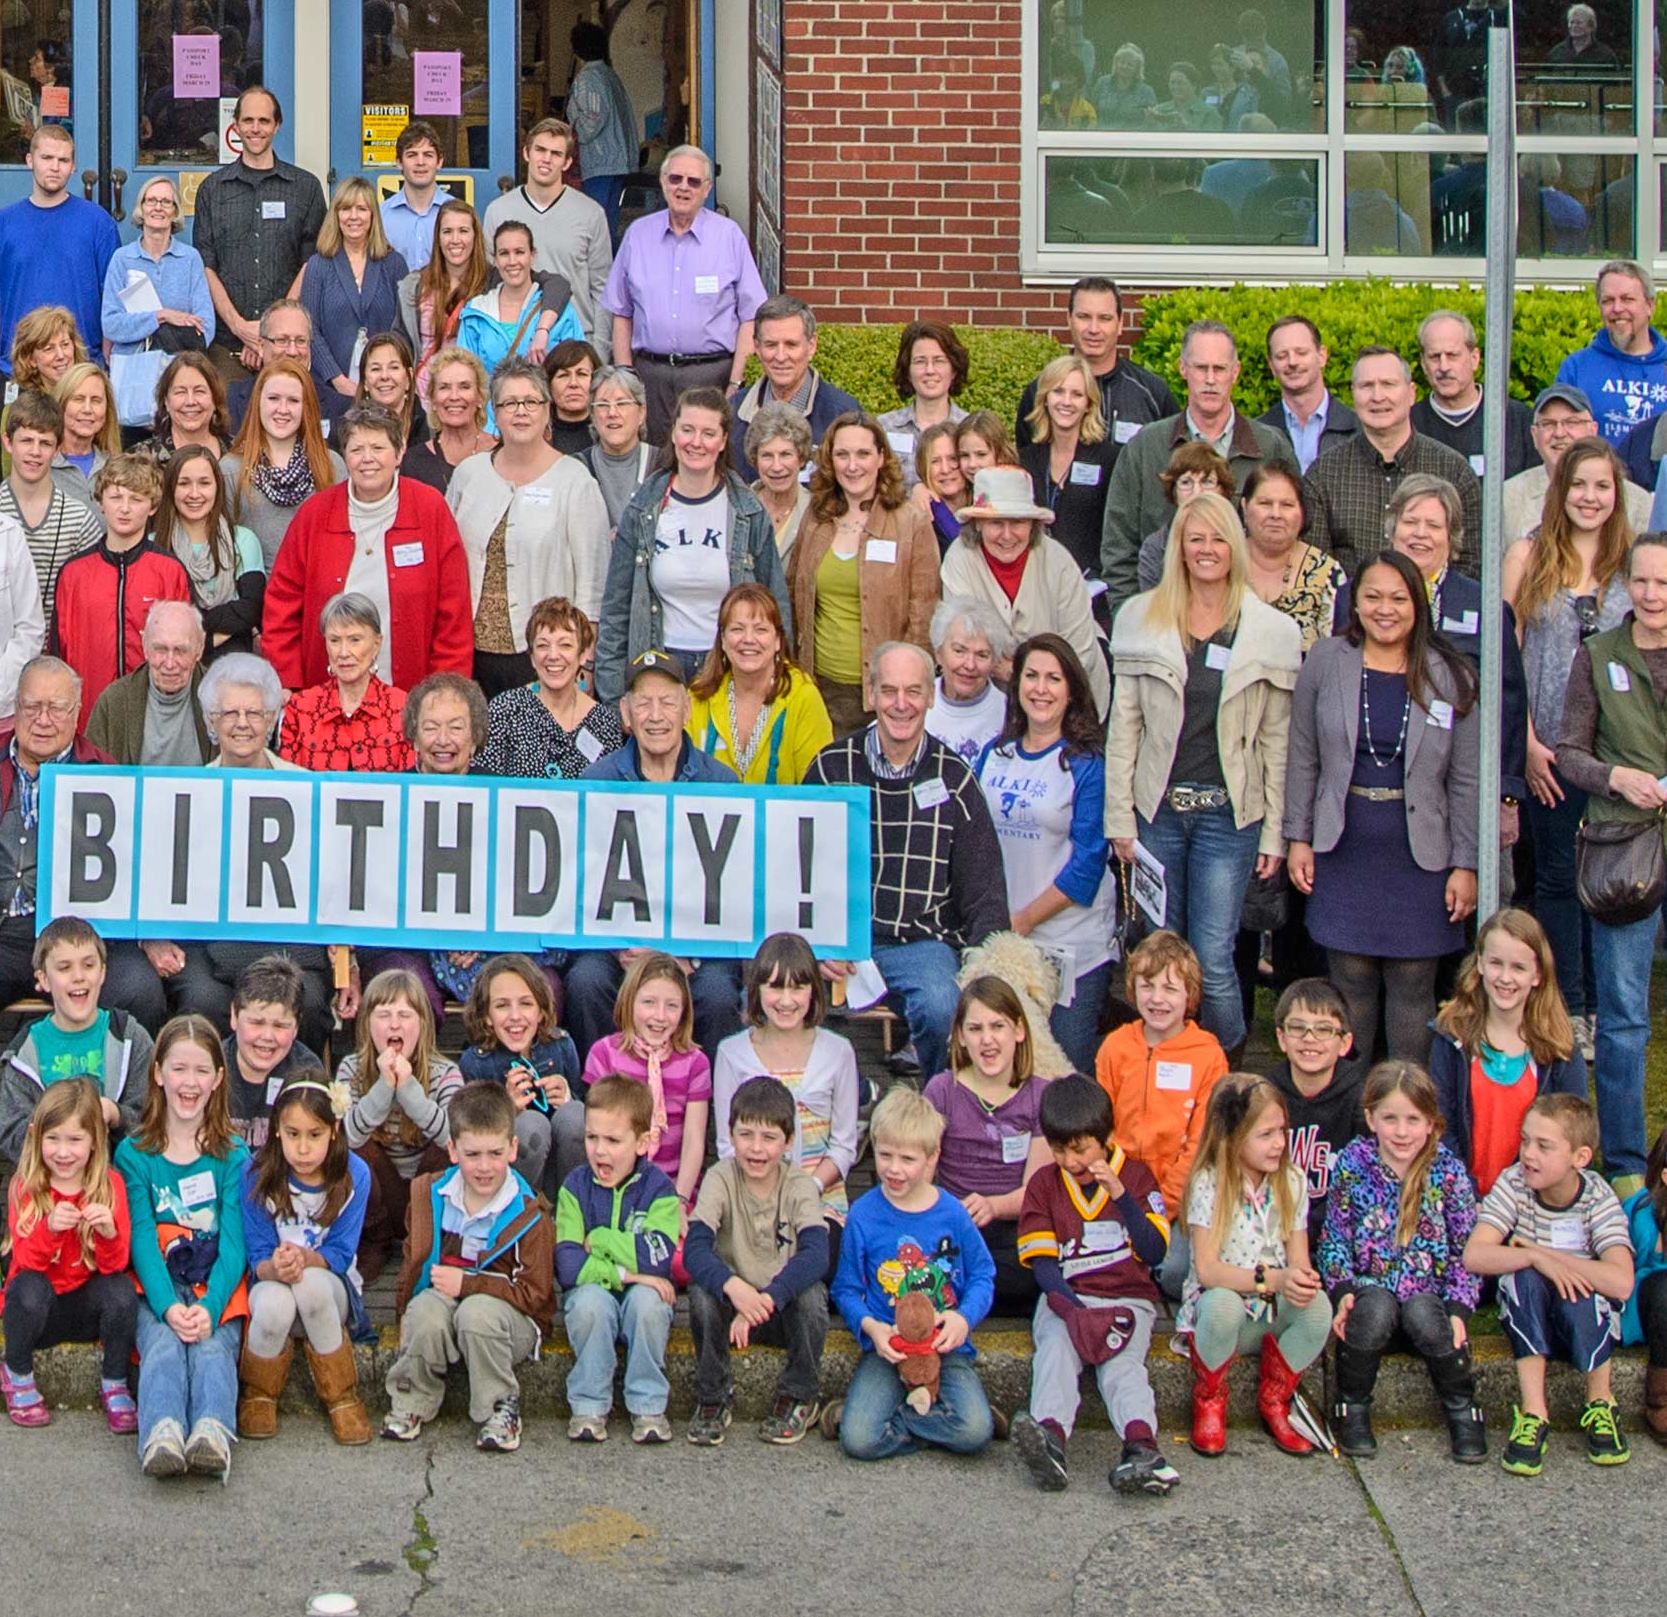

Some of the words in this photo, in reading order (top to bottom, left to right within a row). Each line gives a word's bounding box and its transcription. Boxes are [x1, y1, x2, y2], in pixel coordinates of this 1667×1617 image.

[365, 106, 407, 115] VISITORS
[1602, 379, 1649, 396] ALKI
[989, 774, 1032, 791] ALKI
[67, 790, 815, 930] BIRTHDAY!
